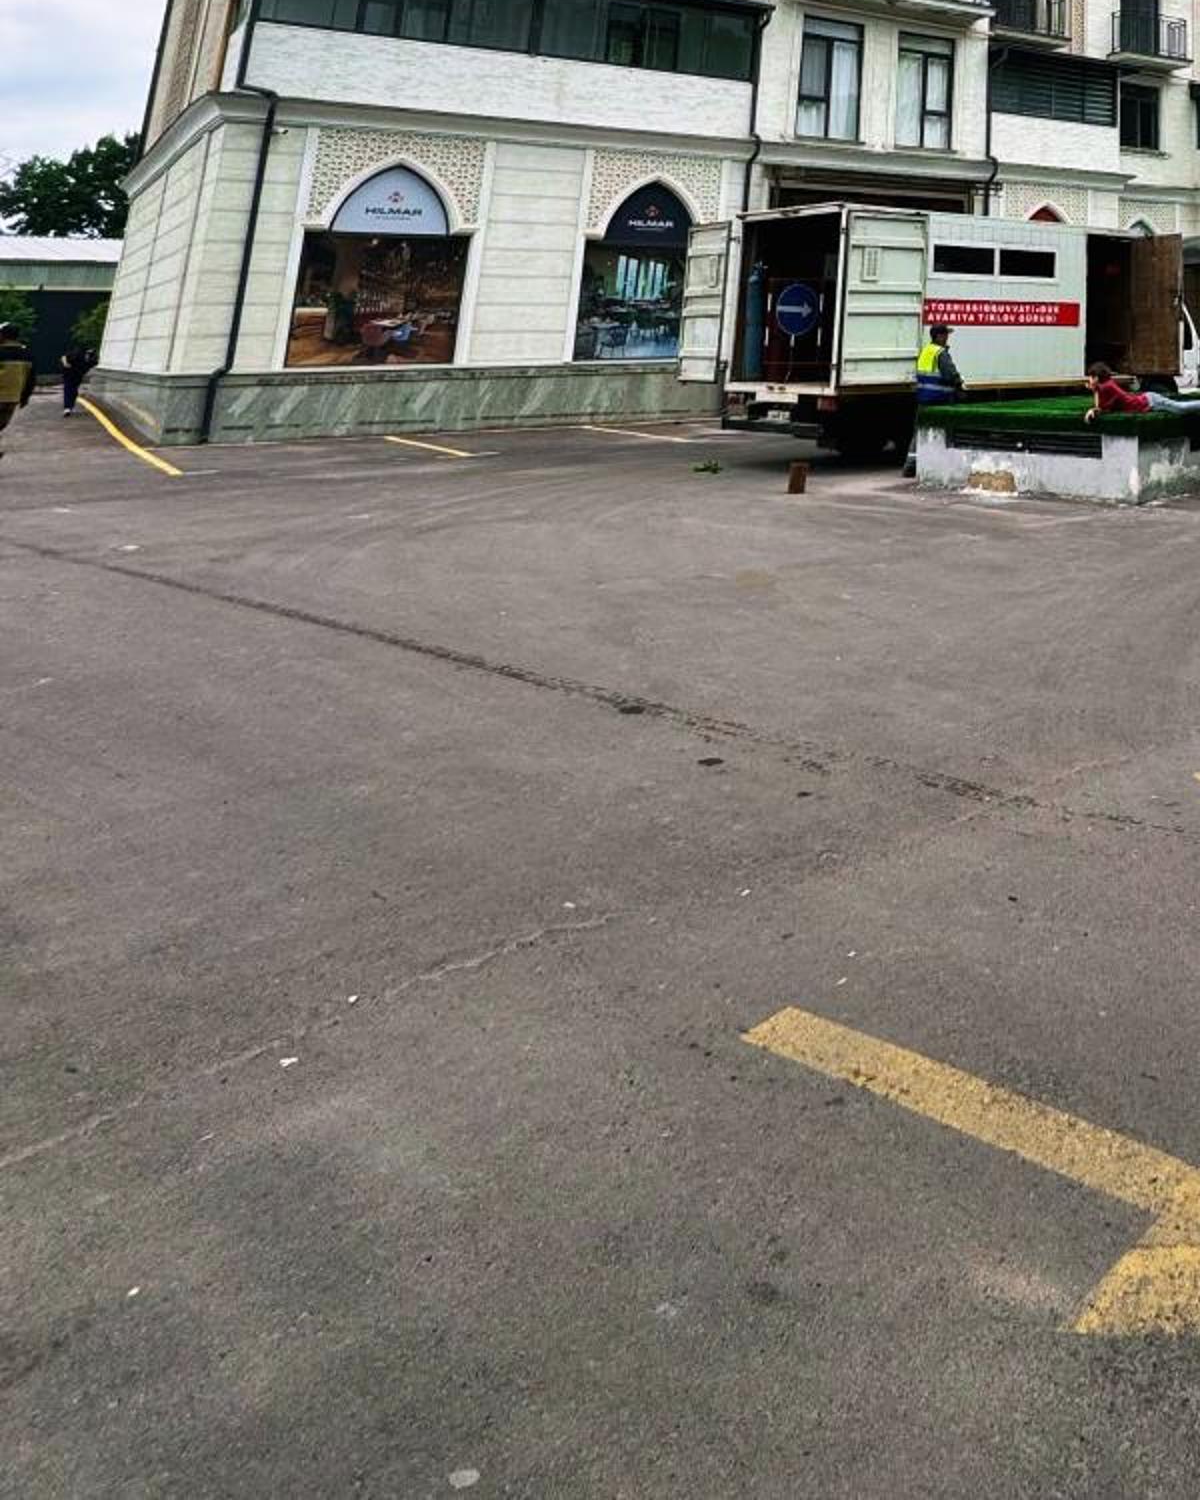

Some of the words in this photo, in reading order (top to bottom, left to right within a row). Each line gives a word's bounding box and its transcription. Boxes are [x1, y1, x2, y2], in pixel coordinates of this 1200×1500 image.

[365, 207, 423, 216] HILMAR
[628, 219, 674, 228] HILMAR
[928, 312, 975, 322] AVARIYA
